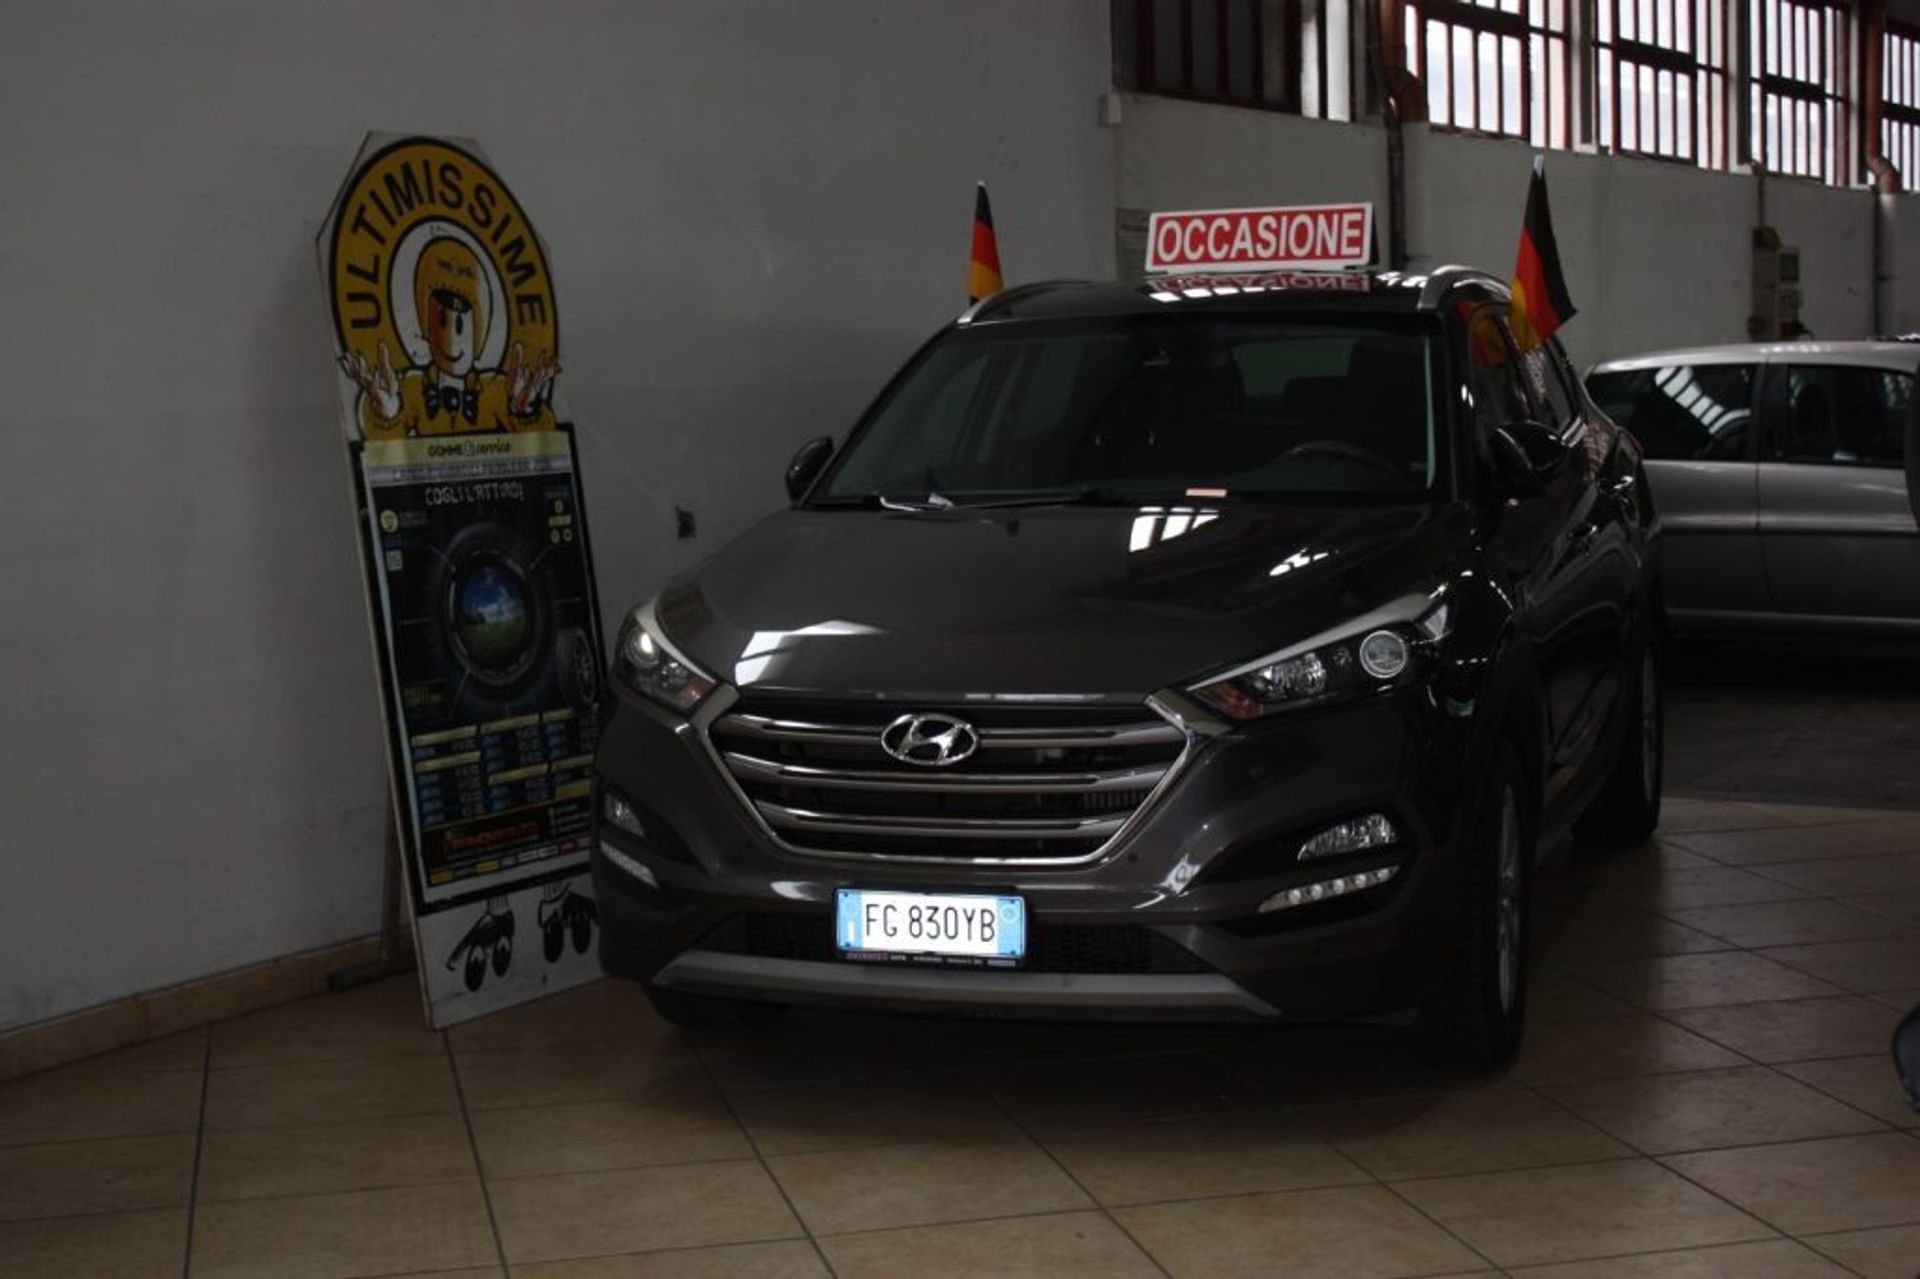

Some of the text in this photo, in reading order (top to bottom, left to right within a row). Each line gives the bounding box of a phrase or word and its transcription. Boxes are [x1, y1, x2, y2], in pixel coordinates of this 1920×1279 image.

[346, 158, 547, 329] ULTIMISSIME
[1156, 211, 1363, 263] OCCASIONE
[865, 903, 996, 943] FG 830YB
